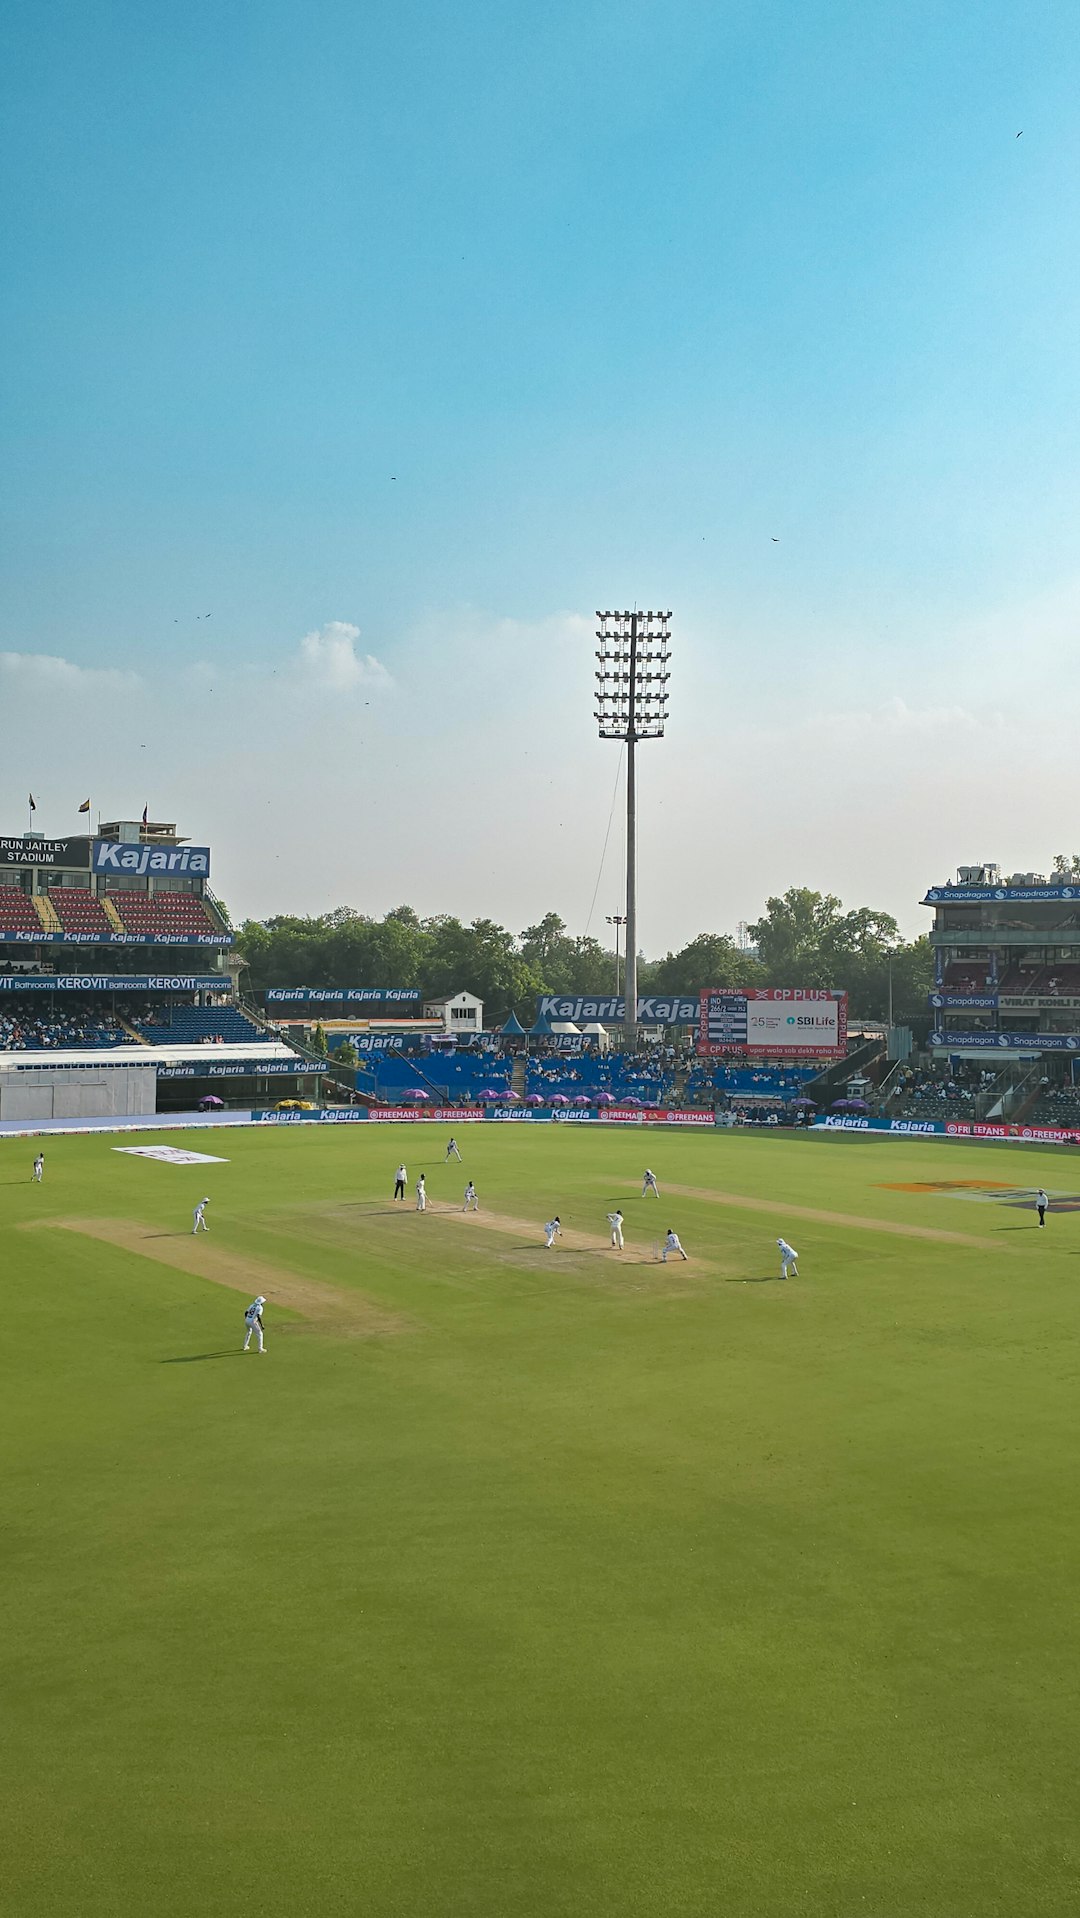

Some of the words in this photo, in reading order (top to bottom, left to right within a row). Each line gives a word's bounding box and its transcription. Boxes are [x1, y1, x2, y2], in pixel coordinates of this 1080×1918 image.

[26, 842, 68, 852] JAITLEY
[7, 851, 54, 862] STADIUM
[97, 843, 208, 874] Kajaria
[944, 891, 991, 899] Snapdragon
[1010, 890, 1058, 898] Snapdragon
[15, 931, 54, 942] Kajaria
[63, 932, 100, 943] Kajaria
[110, 933, 146, 943] Kajaria
[154, 934, 188, 943] Kajaria
[198, 935, 231, 944] Kajaria
[57, 978, 108, 989] KEROVIT
[148, 978, 196, 988] KEROVIT
[268, 990, 304, 1000] Kajaria
[308, 990, 343, 1000] Kajaria
[347, 991, 381, 1000] Kajaria
[385, 990, 418, 999] Kajaria
[774, 990, 791, 1000] CP
[794, 990, 827, 1001] PLUS
[947, 998, 994, 1007] Snapdragon
[541, 998, 626, 1021] Kajaria
[797, 1016, 814, 1026] SBI
[816, 1016, 836, 1026] Life
[839, 1012, 847, 1024] CP
[701, 1020, 708, 1031] CP
[349, 1035, 403, 1050] Kajaria
[947, 1037, 994, 1046] Snapdragon
[1014, 1037, 1062, 1047] Snapdragon
[158, 1067, 194, 1076] Kajaria
[209, 1066, 245, 1075] Kajaria
[254, 1063, 288, 1073] Kajaria
[294, 1062, 327, 1072] Kajaria
[261, 1111, 301, 1121] Kajaria
[320, 1109, 359, 1120] Kajaria
[378, 1111, 419, 1119] FREEMANS
[494, 1109, 532, 1118] Kajaria
[551, 1109, 589, 1119] Kajaria
[609, 1111, 647, 1120] FREEMAS
[675, 1113, 713, 1121] FREEMANS
[826, 1117, 868, 1128] Kajaria
[890, 1120, 934, 1132] Kajaria
